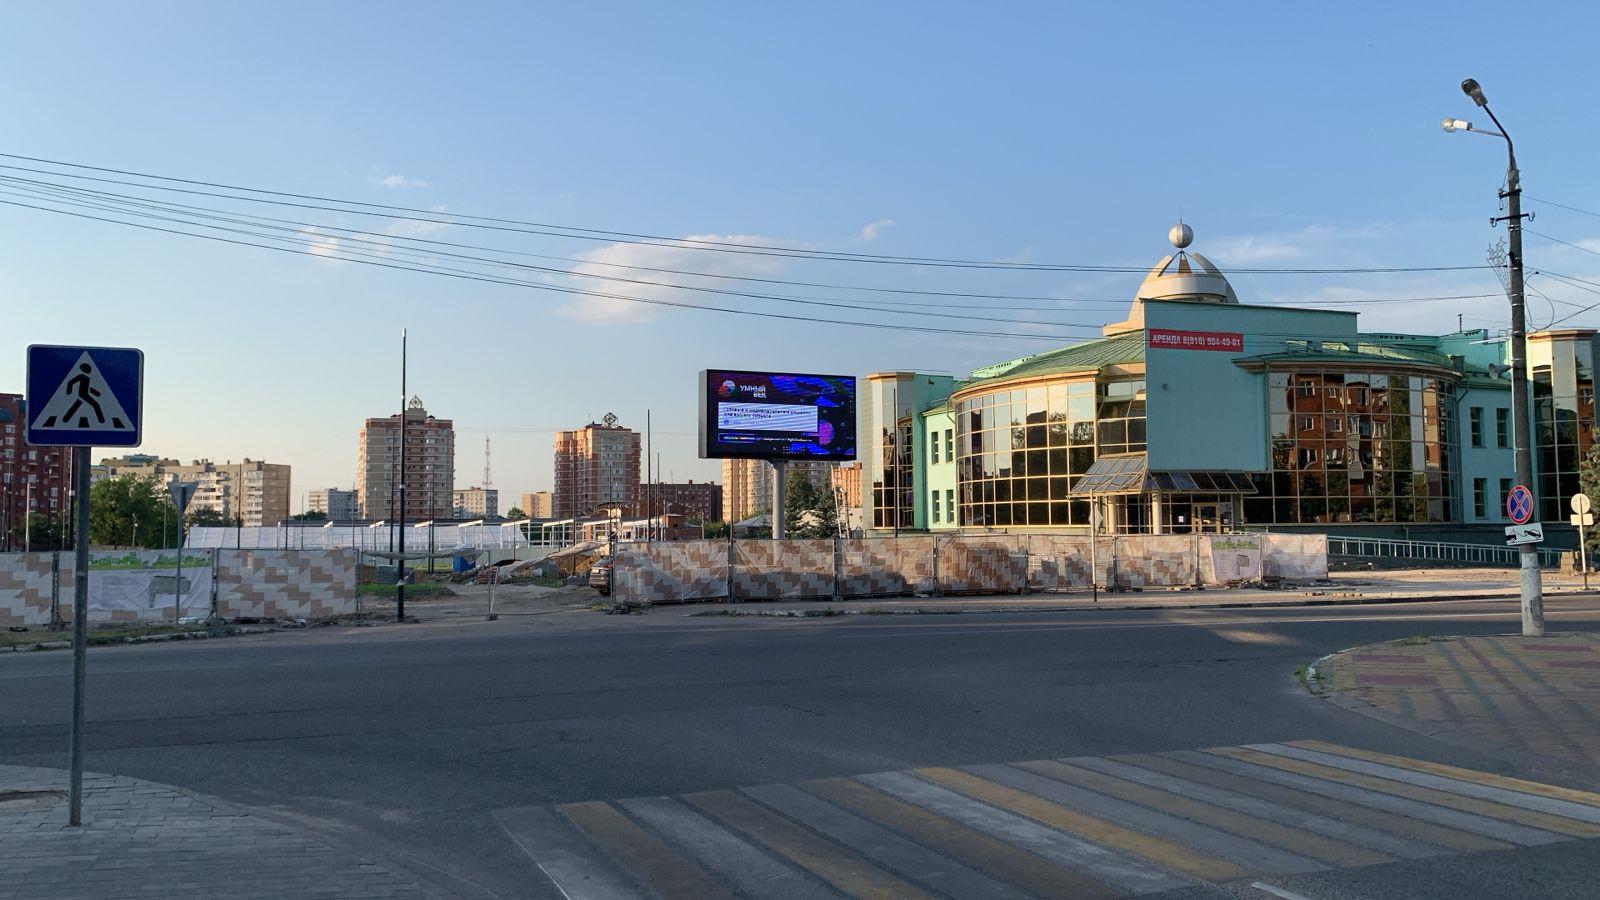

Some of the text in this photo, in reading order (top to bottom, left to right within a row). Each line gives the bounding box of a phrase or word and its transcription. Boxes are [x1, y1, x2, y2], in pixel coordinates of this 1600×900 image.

[1152, 334, 1181, 345] АРЕНДА
[1182, 336, 1205, 346] 8(916)
[740, 384, 766, 393] УМНЫЙ
